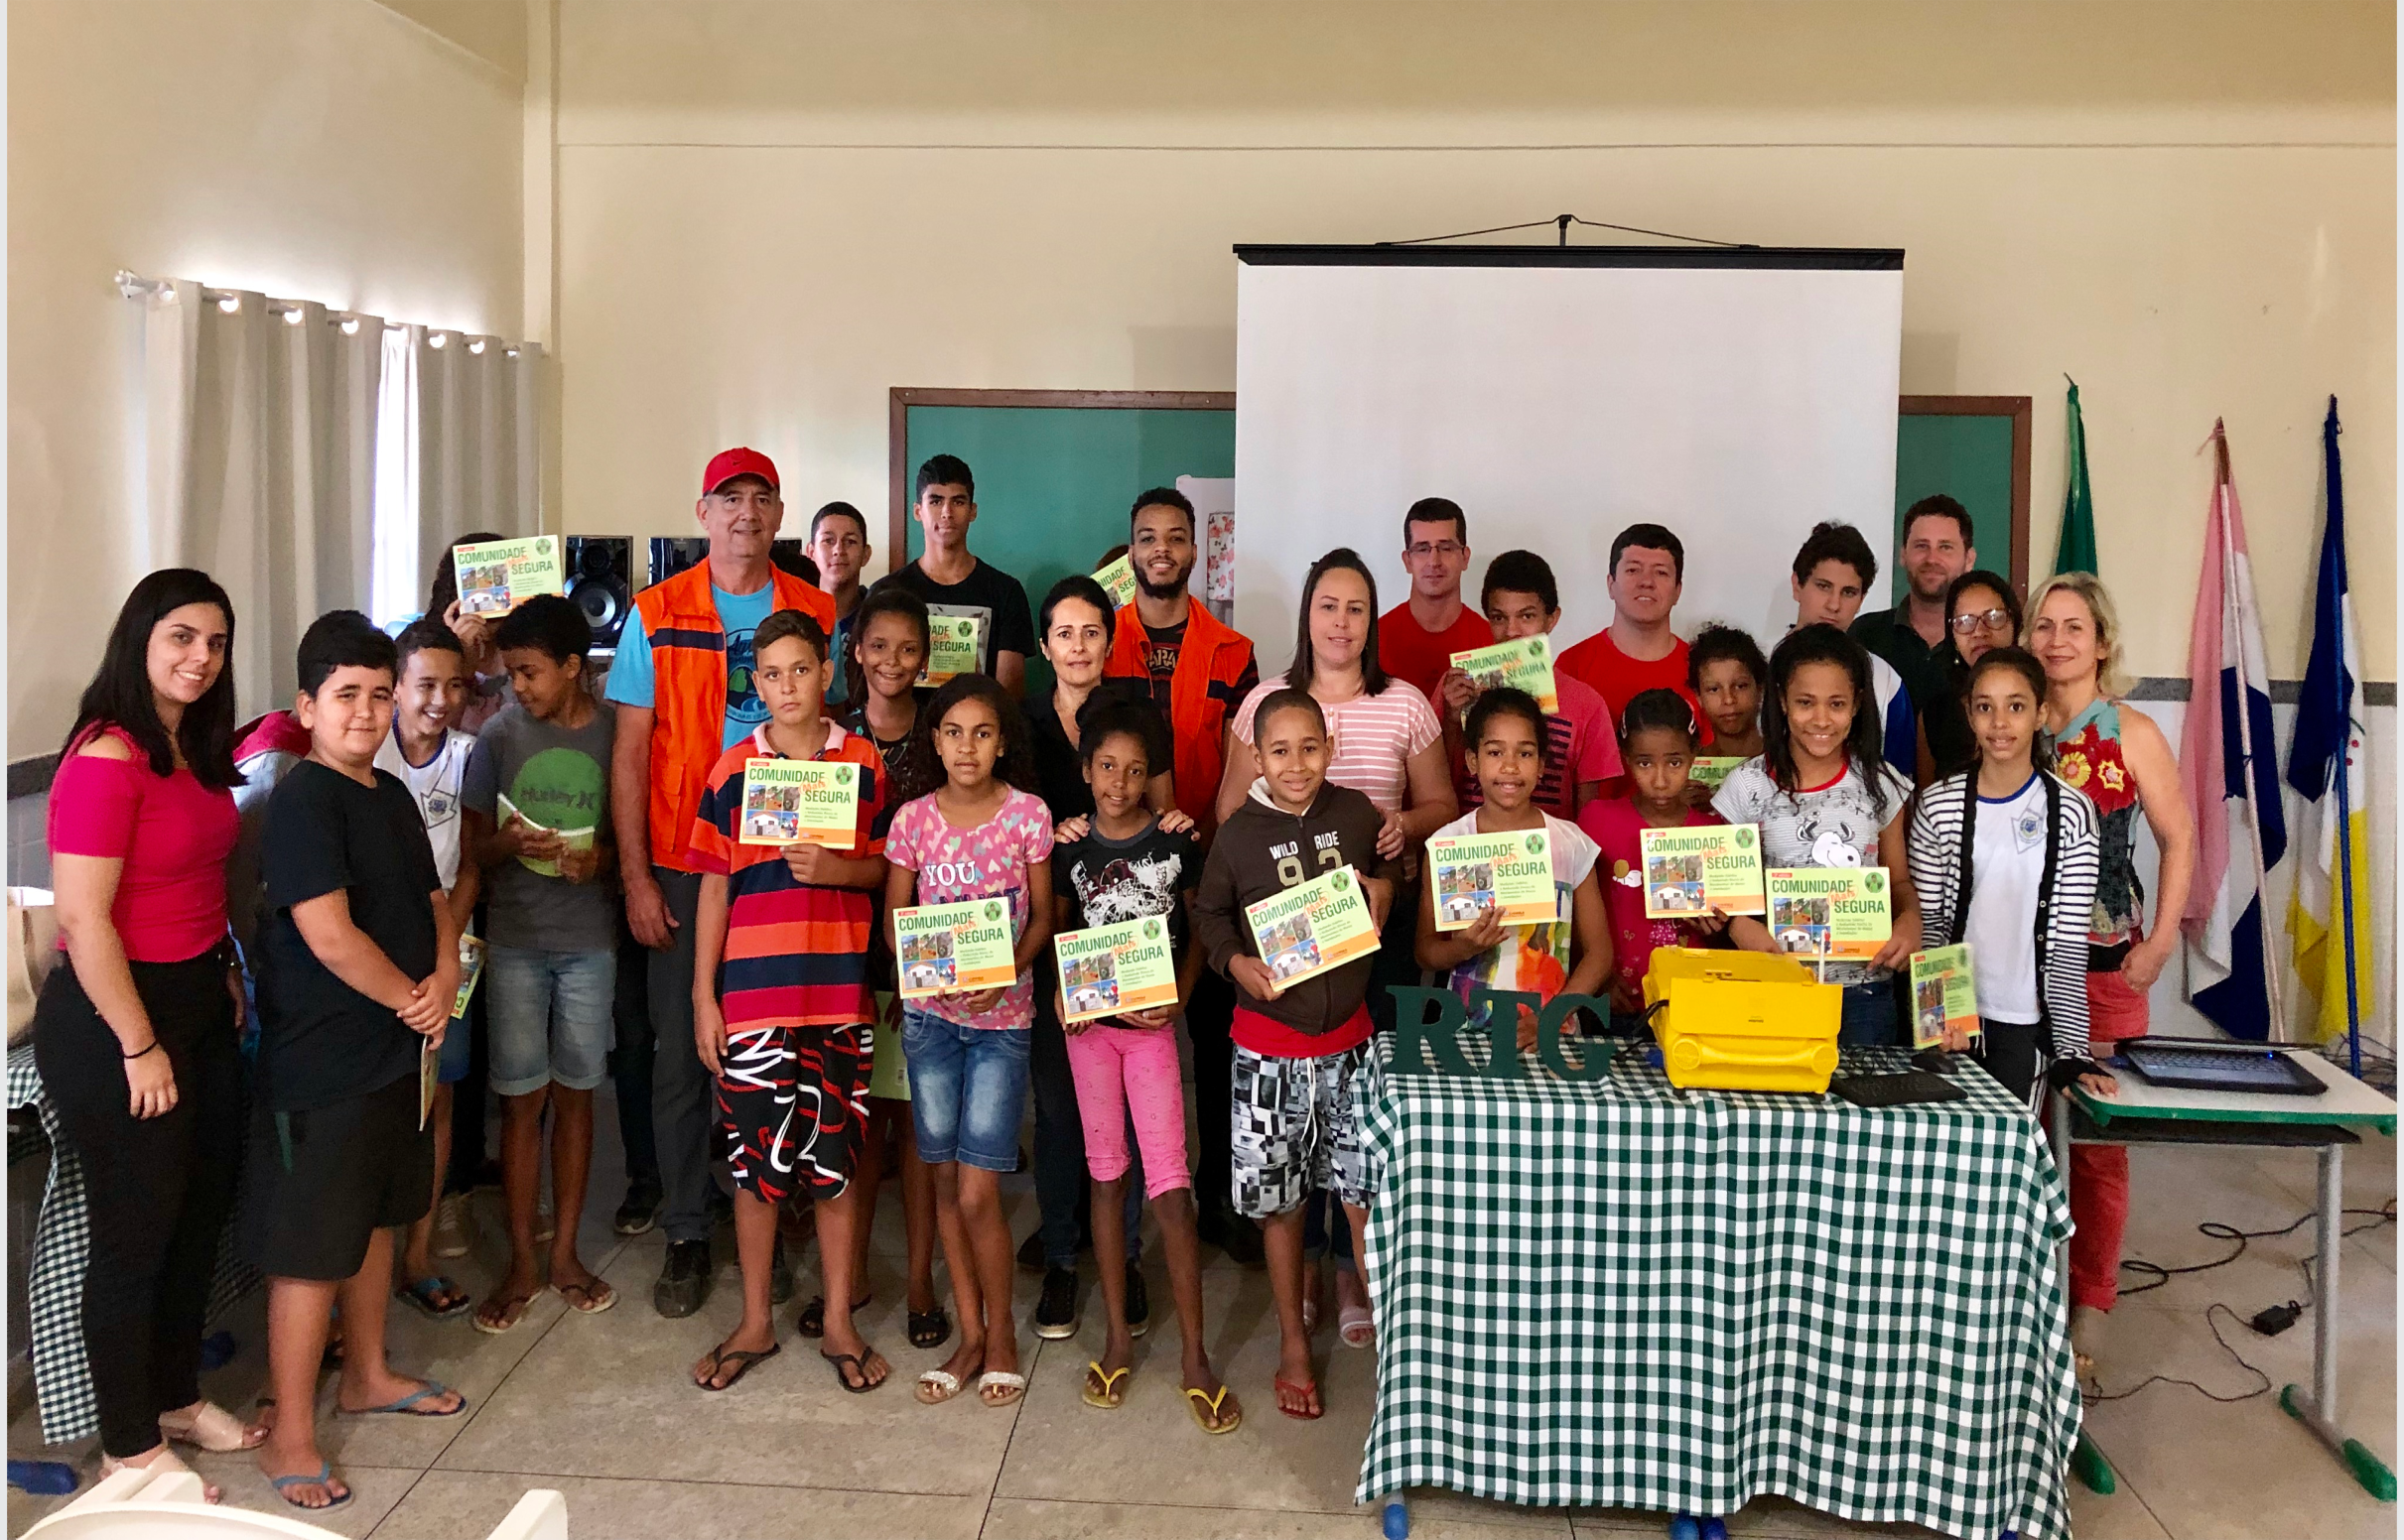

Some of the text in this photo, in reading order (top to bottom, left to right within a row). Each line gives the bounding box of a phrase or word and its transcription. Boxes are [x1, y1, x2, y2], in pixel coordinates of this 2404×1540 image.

[458, 547, 527, 565] COMUNIDADE
[511, 561, 554, 576] SEGURA
[932, 641, 971, 653] SEGURA
[748, 768, 825, 784] COMUNIDADE
[804, 790, 851, 804] SEGURA
[1269, 831, 1340, 860] WILD RIDE
[1435, 843, 1515, 862] COMUNIDADE
[1647, 836, 1725, 852] COMUNIDADE
[1497, 861, 1546, 877] SEGURA
[1706, 855, 1756, 870] SEGURA
[925, 860, 976, 887] YOU
[1772, 879, 1853, 893] COMUNIDADE
[1252, 886, 1324, 928] COMUNIDADE
[1311, 895, 1358, 924] SEGURA
[1833, 900, 1885, 914] SEGURA
[898, 911, 975, 932] COMUNIDADE
[957, 927, 1004, 946] SEGURA
[1060, 931, 1134, 957] COMUNIDADE
[1118, 945, 1164, 965] SEGURA
[1382, 984, 1617, 1082] RTG
